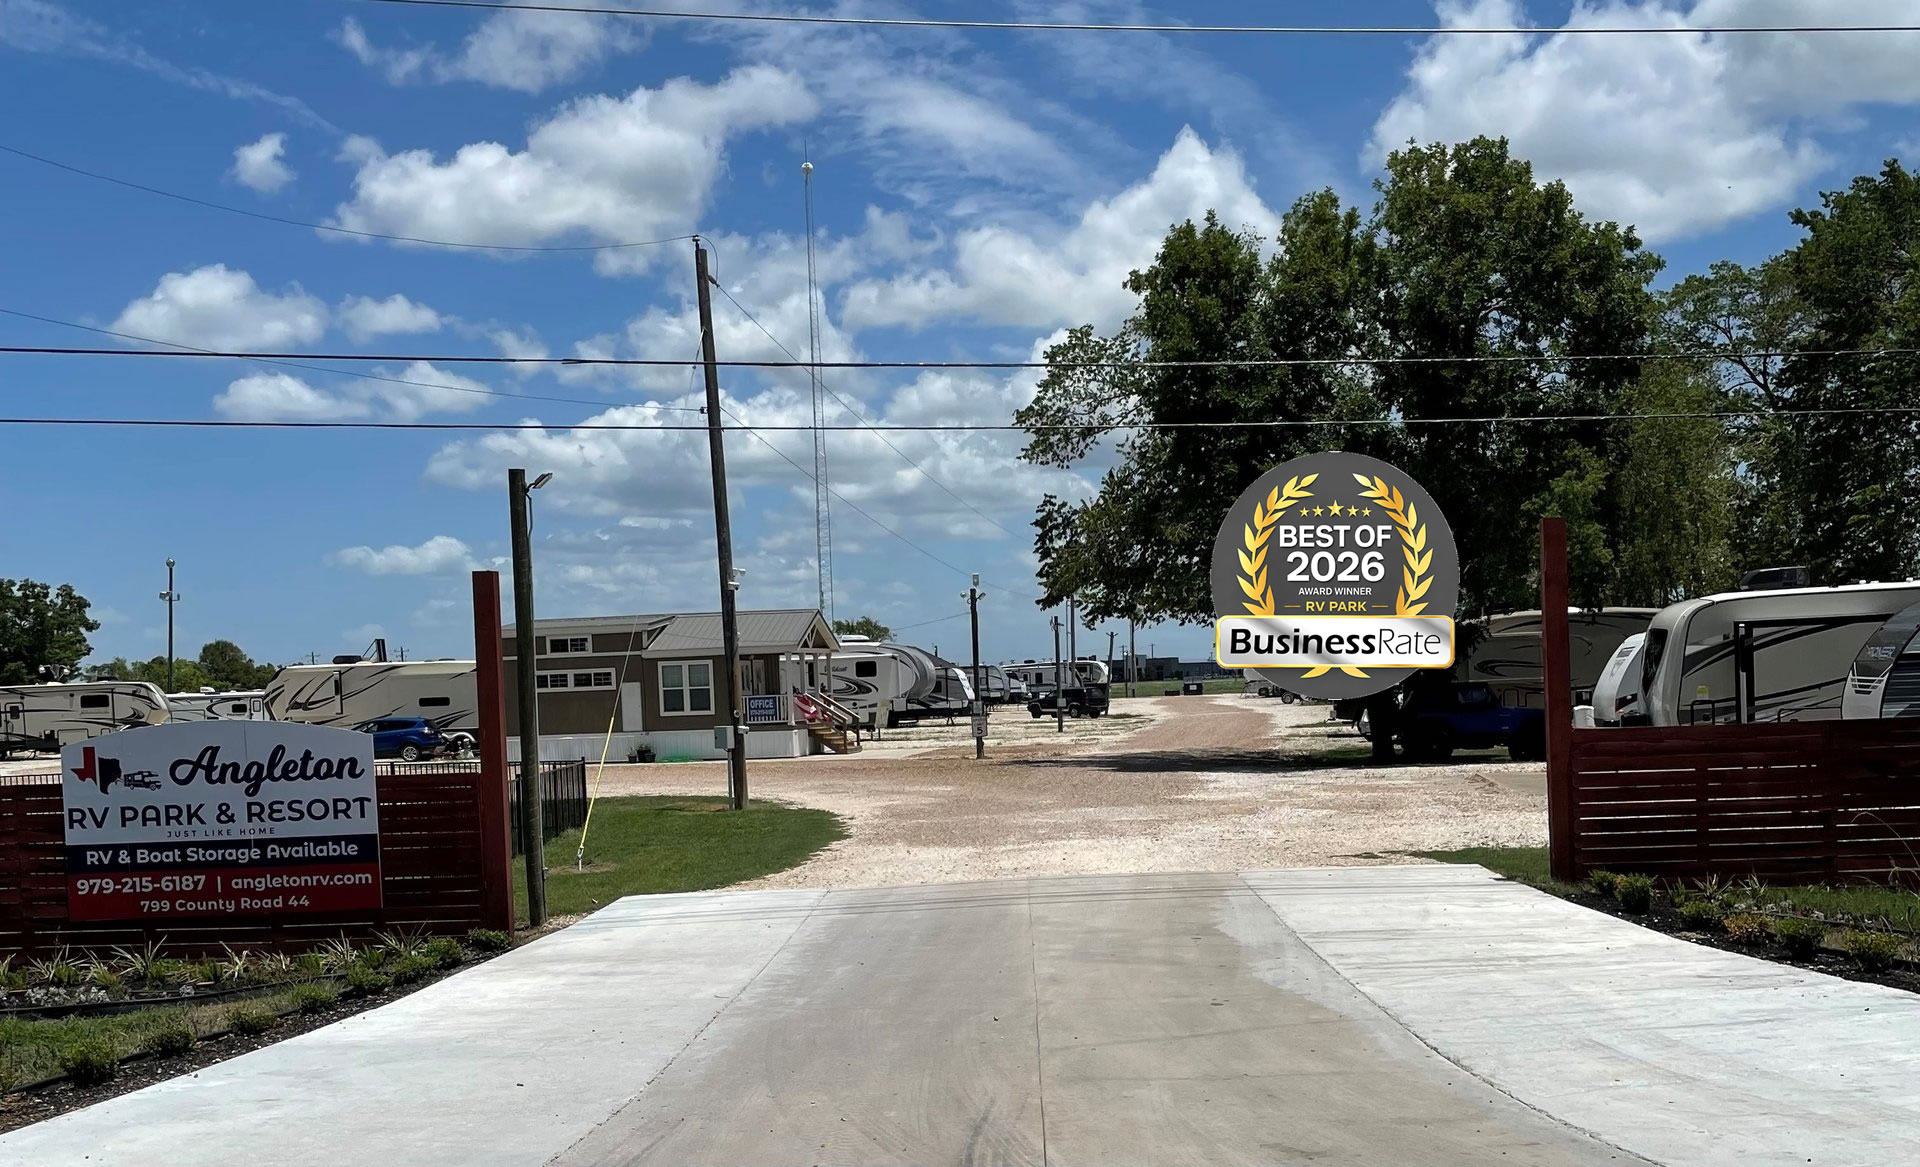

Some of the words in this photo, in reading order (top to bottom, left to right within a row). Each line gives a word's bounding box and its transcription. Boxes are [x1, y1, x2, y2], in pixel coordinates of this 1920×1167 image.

[750, 699, 774, 709] OFFICE
[169, 744, 365, 797] Angleton
[68, 807, 109, 829] RV
[120, 803, 207, 828] PARK
[215, 802, 236, 824] &
[246, 797, 372, 824] RESORT
[167, 830, 197, 838] JUST
[204, 829, 232, 837] LIKE
[239, 827, 275, 836] HOME
[86, 850, 113, 865] RV
[118, 849, 131, 864] &
[136, 849, 181, 863] Boat
[186, 847, 261, 863] Storage
[266, 841, 359, 859] Available
[76, 875, 206, 895] 979-215-6187
[231, 873, 373, 892] angletonrv.com
[140, 900, 170, 912] 799
[175, 898, 236, 913] County
[240, 895, 283, 909] Road
[288, 895, 310, 907] 44
